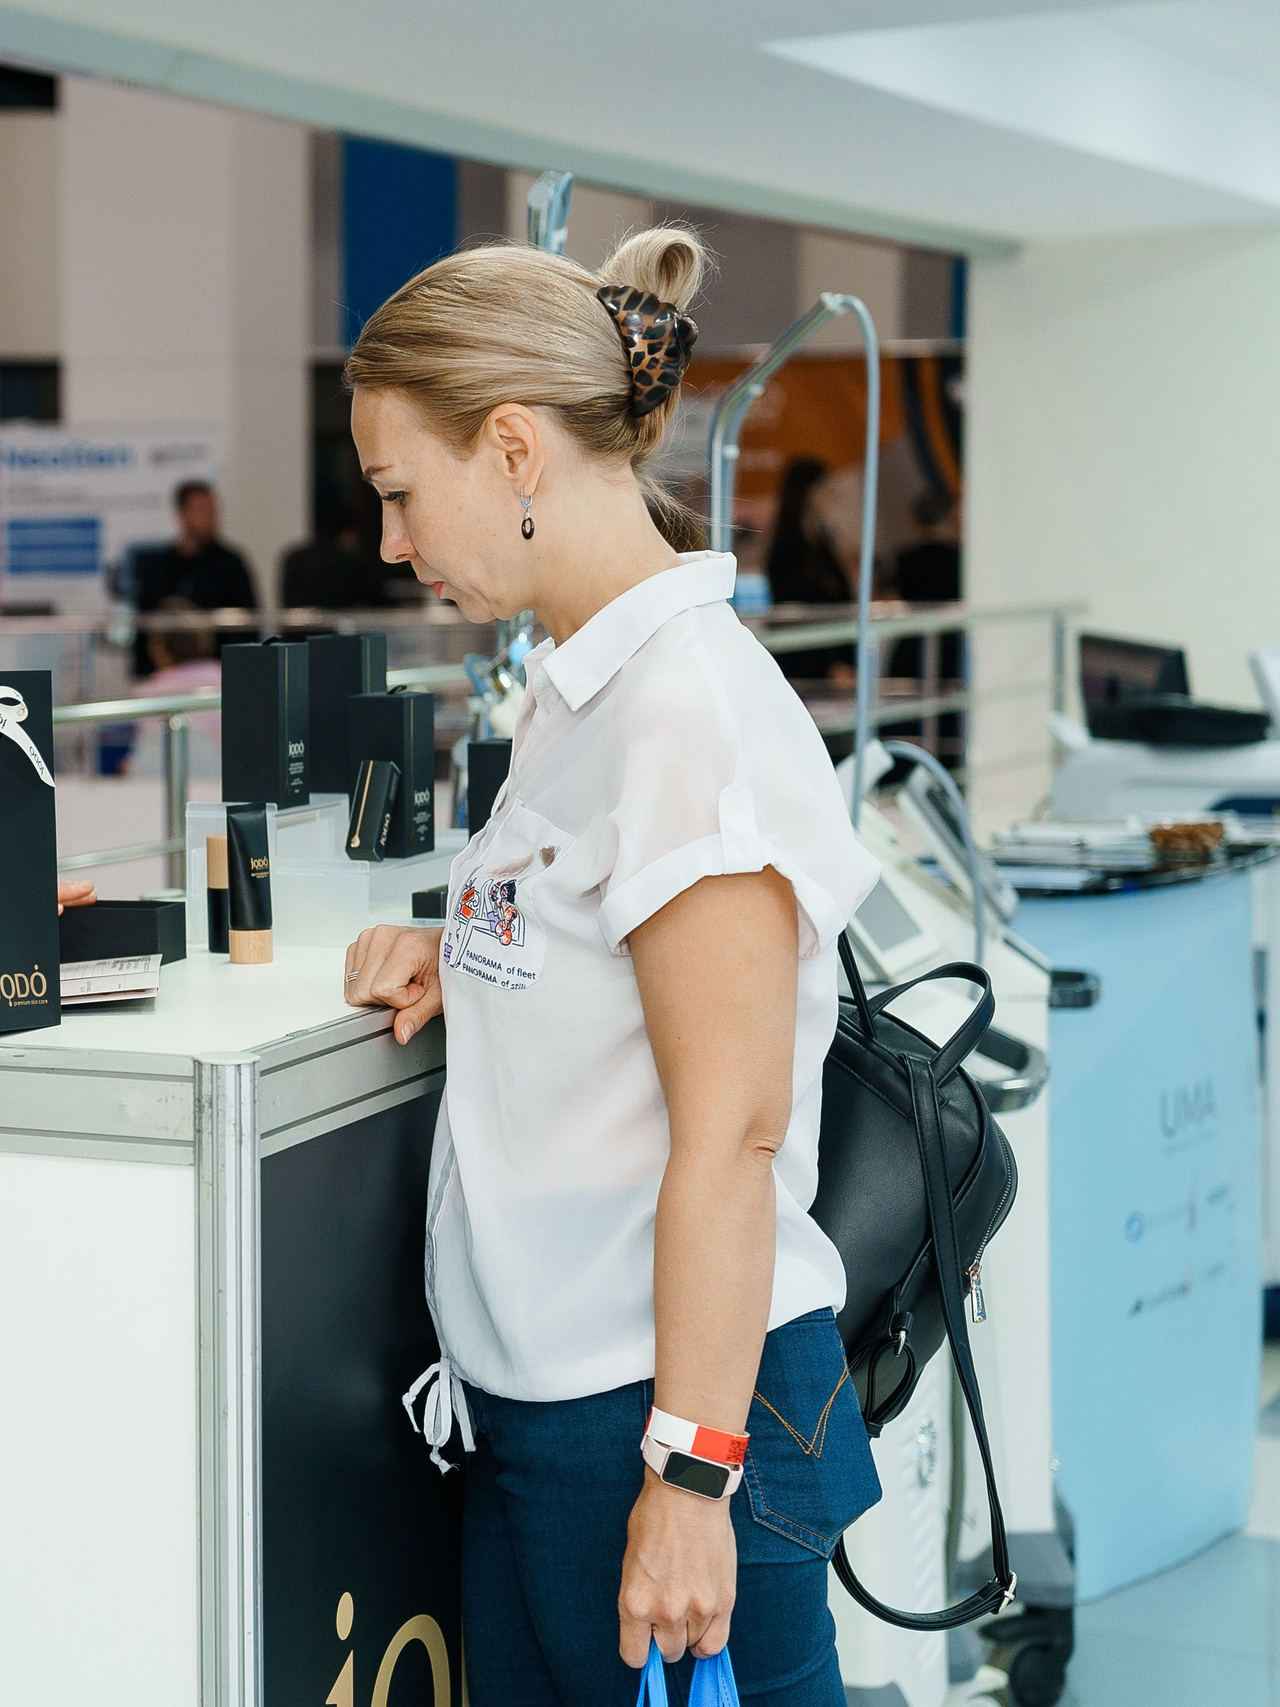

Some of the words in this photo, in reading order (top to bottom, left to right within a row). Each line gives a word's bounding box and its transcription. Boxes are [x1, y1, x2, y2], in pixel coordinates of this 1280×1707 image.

[462, 962, 498, 984] PANORAMA
[500, 980, 510, 988] of
[466, 949, 503, 972] PANORAMA
[506, 966, 516, 975] of
[516, 967, 537, 980] fleet
